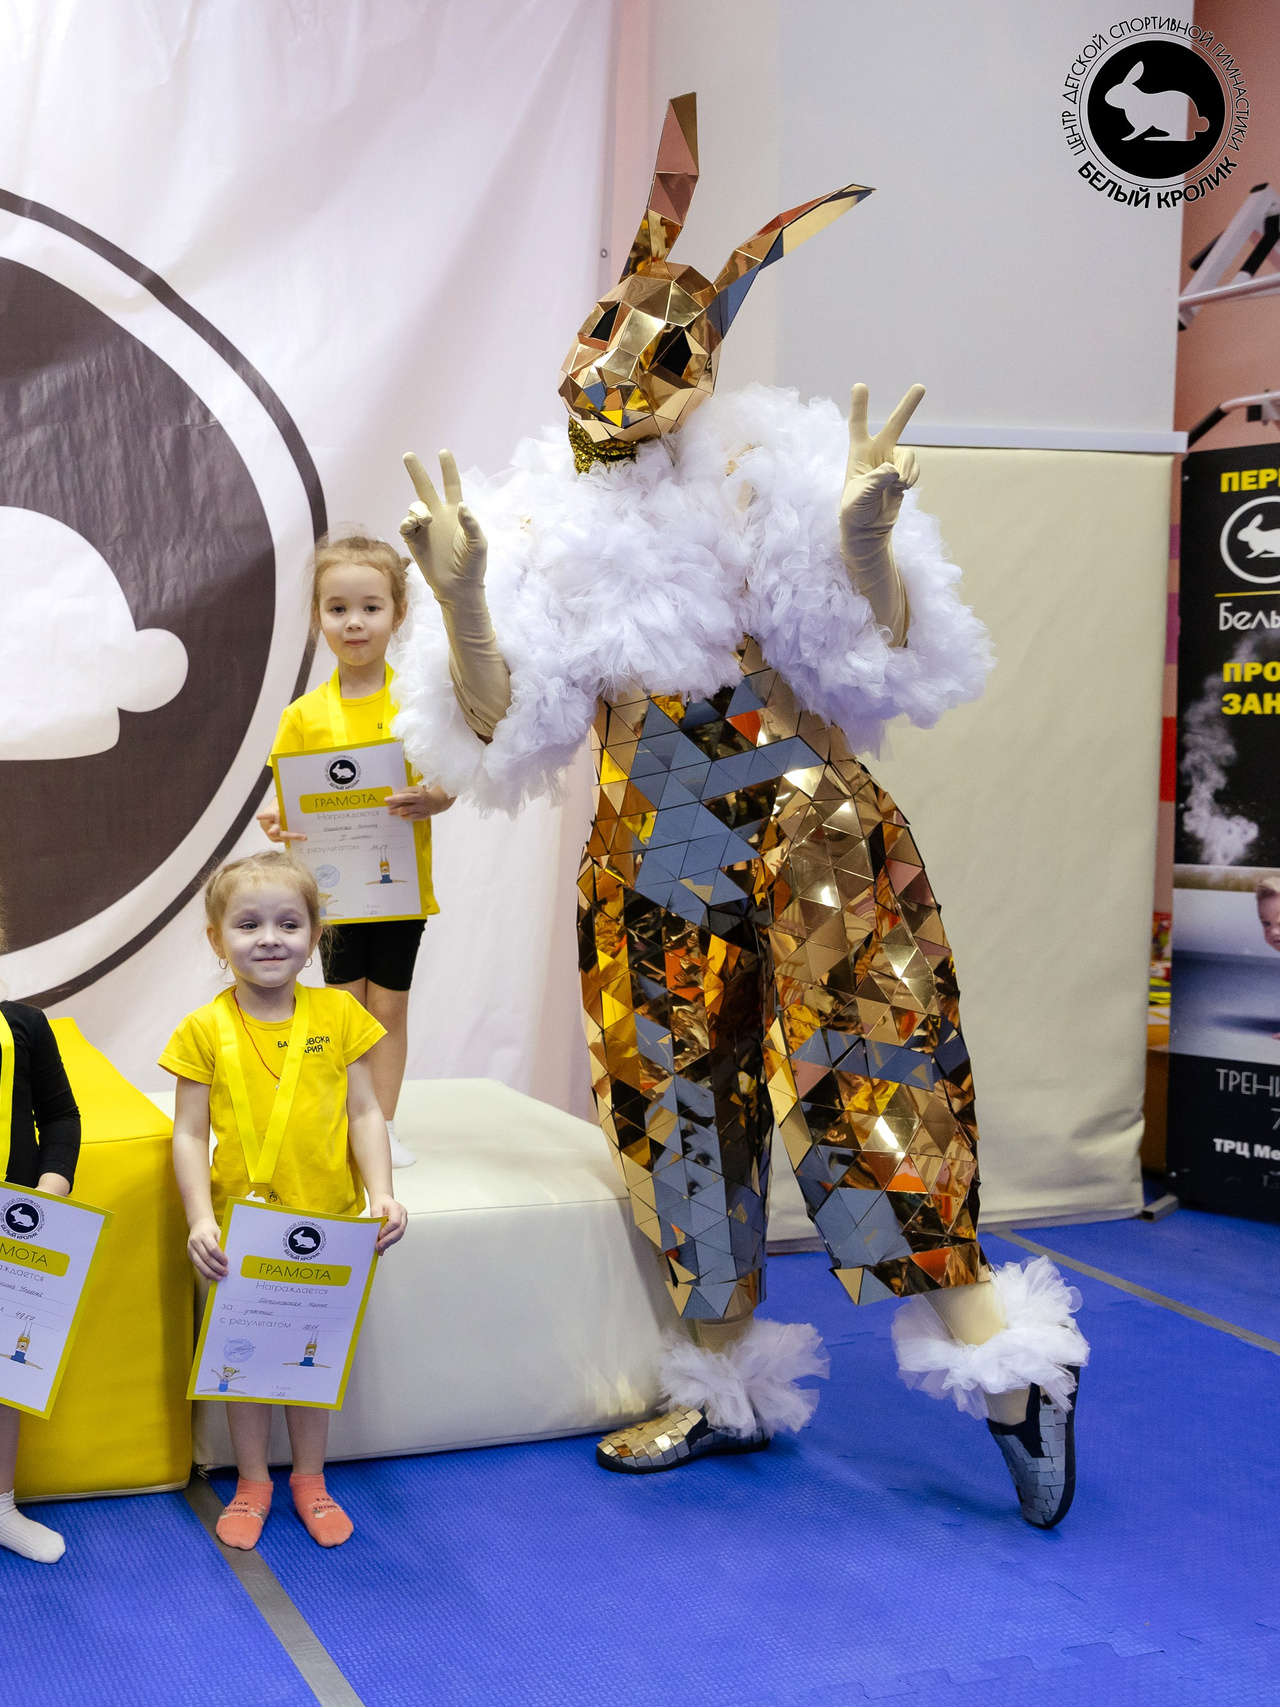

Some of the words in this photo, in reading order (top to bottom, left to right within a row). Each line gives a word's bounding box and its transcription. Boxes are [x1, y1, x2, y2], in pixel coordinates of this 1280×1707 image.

[1220, 468, 1280, 493] ПЕР
[1222, 661, 1280, 682] ПРО
[1221, 692, 1280, 716] ЗАН
[314, 794, 378, 807] ГРАМОТА
[318, 810, 380, 820] Награждается
[307, 844, 360, 854] результатом
[1216, 1068, 1280, 1098] ТРЕН
[1213, 1138, 1250, 1159] ТРЦ
[259, 1263, 331, 1280] ГРАМОТА
[256, 1281, 328, 1295] Награждается
[229, 1318, 291, 1329] результатом
